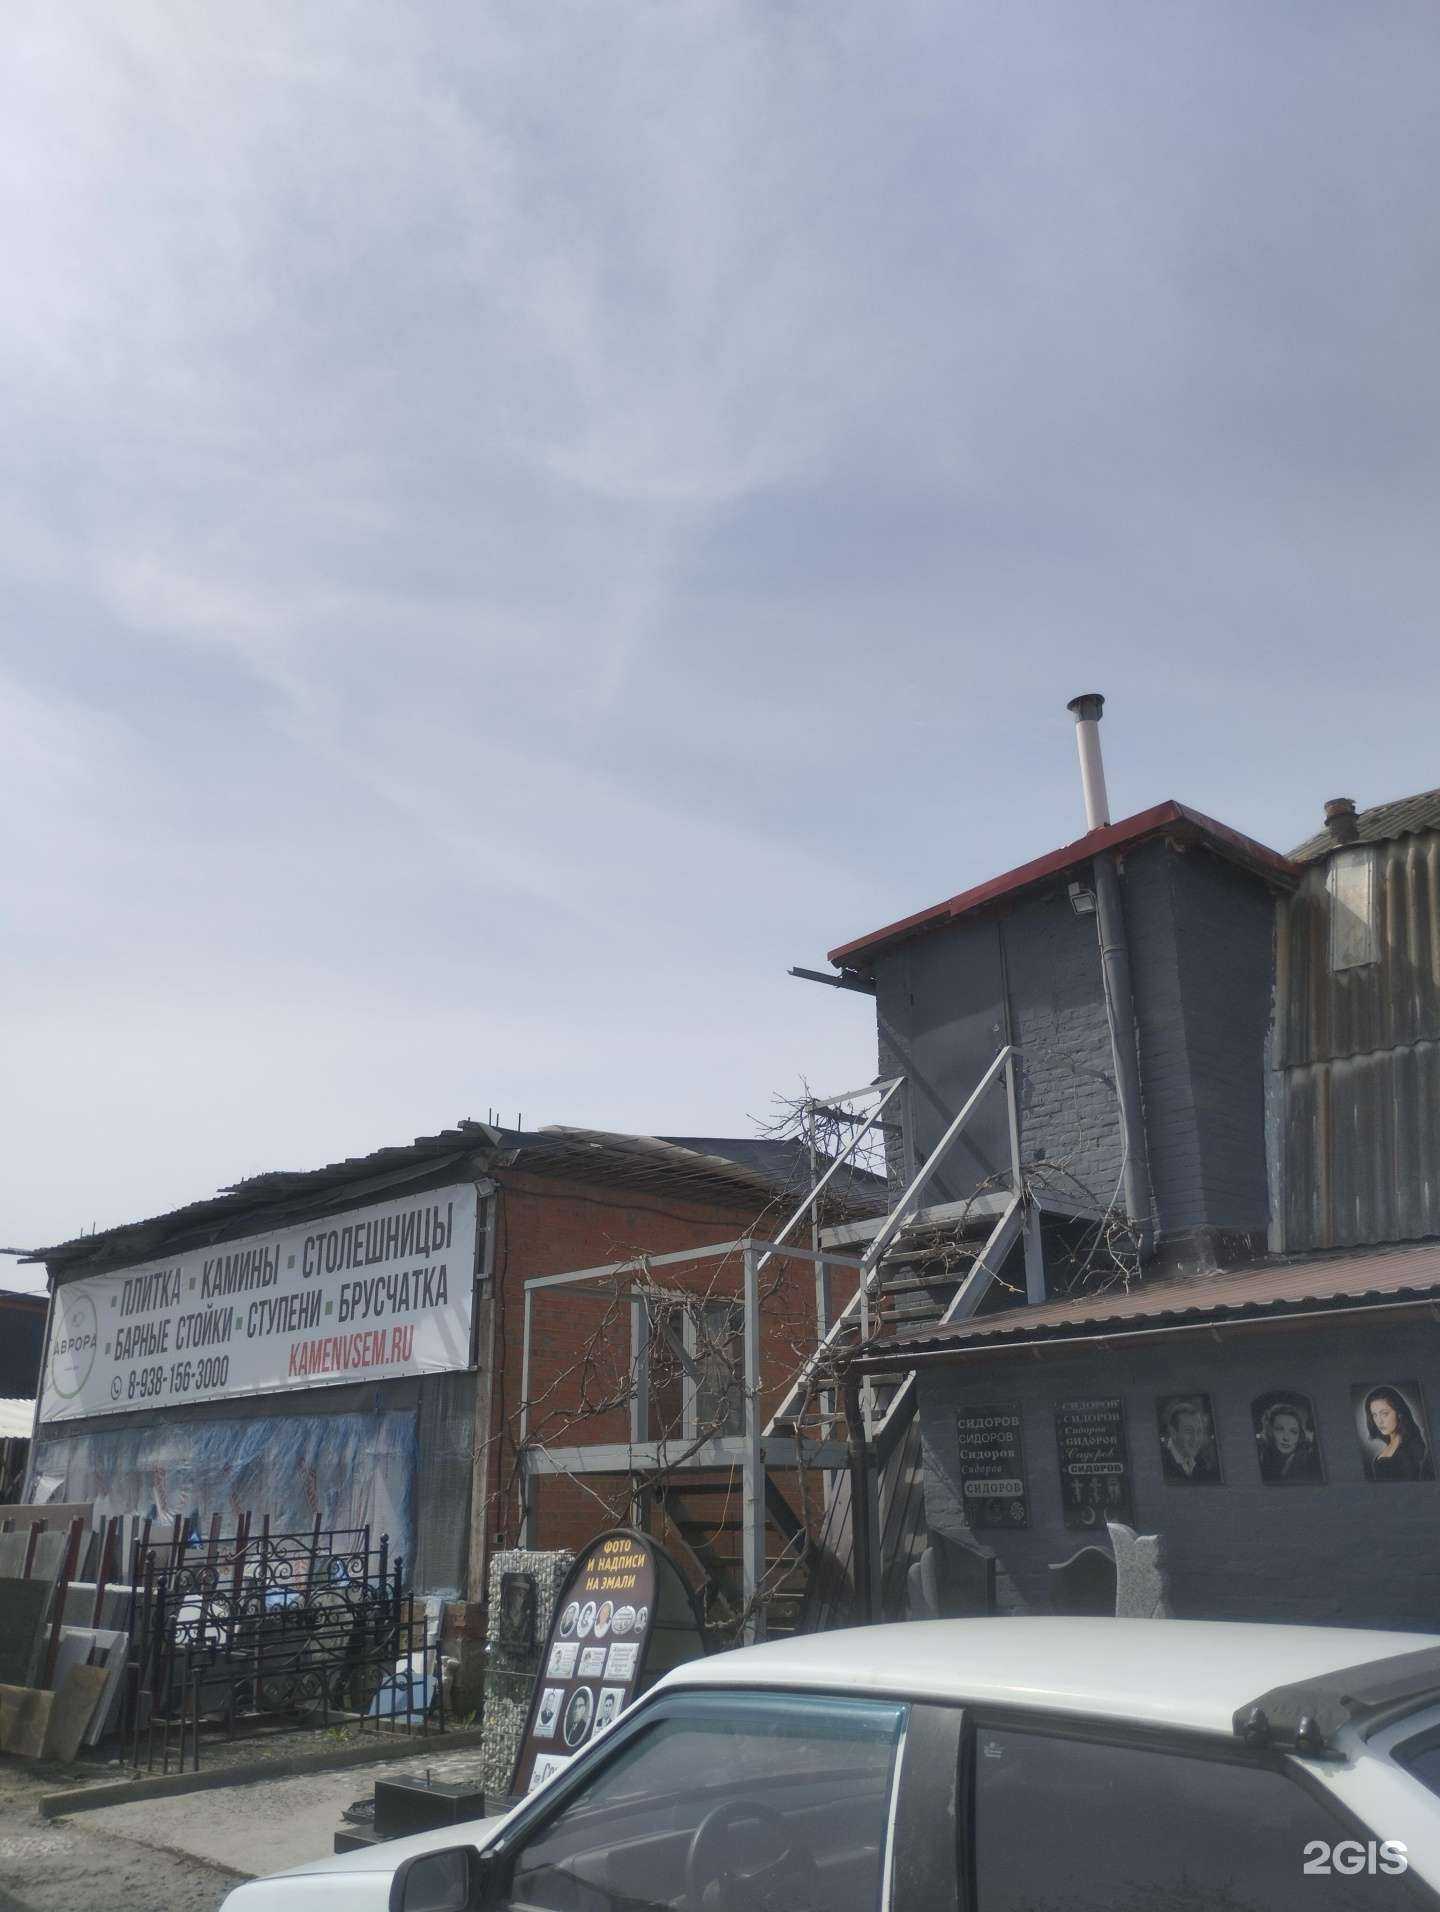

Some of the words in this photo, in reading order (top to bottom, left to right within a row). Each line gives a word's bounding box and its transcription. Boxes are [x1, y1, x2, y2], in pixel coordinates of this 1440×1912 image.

[120, 1268, 182, 1316] ПЛИТКА
[201, 1244, 281, 1299] КАМИНЫ
[302, 1202, 454, 1278] СТОЛЕШНИЦЫ
[114, 1319, 171, 1360] БАРНЫЕ
[176, 1303, 234, 1350] СТОЙКИ
[247, 1289, 322, 1338] СТУПЕНИ
[338, 1264, 448, 1322] БРУСЧАТКА
[53, 1334, 97, 1356] АВРОРА
[288, 1325, 414, 1377] KAMENVSEM.RU
[127, 1355, 229, 1399] 8-938-156-3000
[958, 1416, 1020, 1430] СИДОРОВ
[958, 1431, 1015, 1445] СИДОРОВ
[959, 1447, 1016, 1462] Сидоров
[1070, 1465, 1122, 1474] СИДОРОВ
[966, 1482, 1023, 1496] СИДОРОВ
[604, 1539, 632, 1554] ФОТО
[587, 1558, 595, 1572] И
[598, 1554, 646, 1572] НАДПИСИ
[586, 1575, 599, 1591] НА
[600, 1574, 636, 1590] ЭМАЛИ
